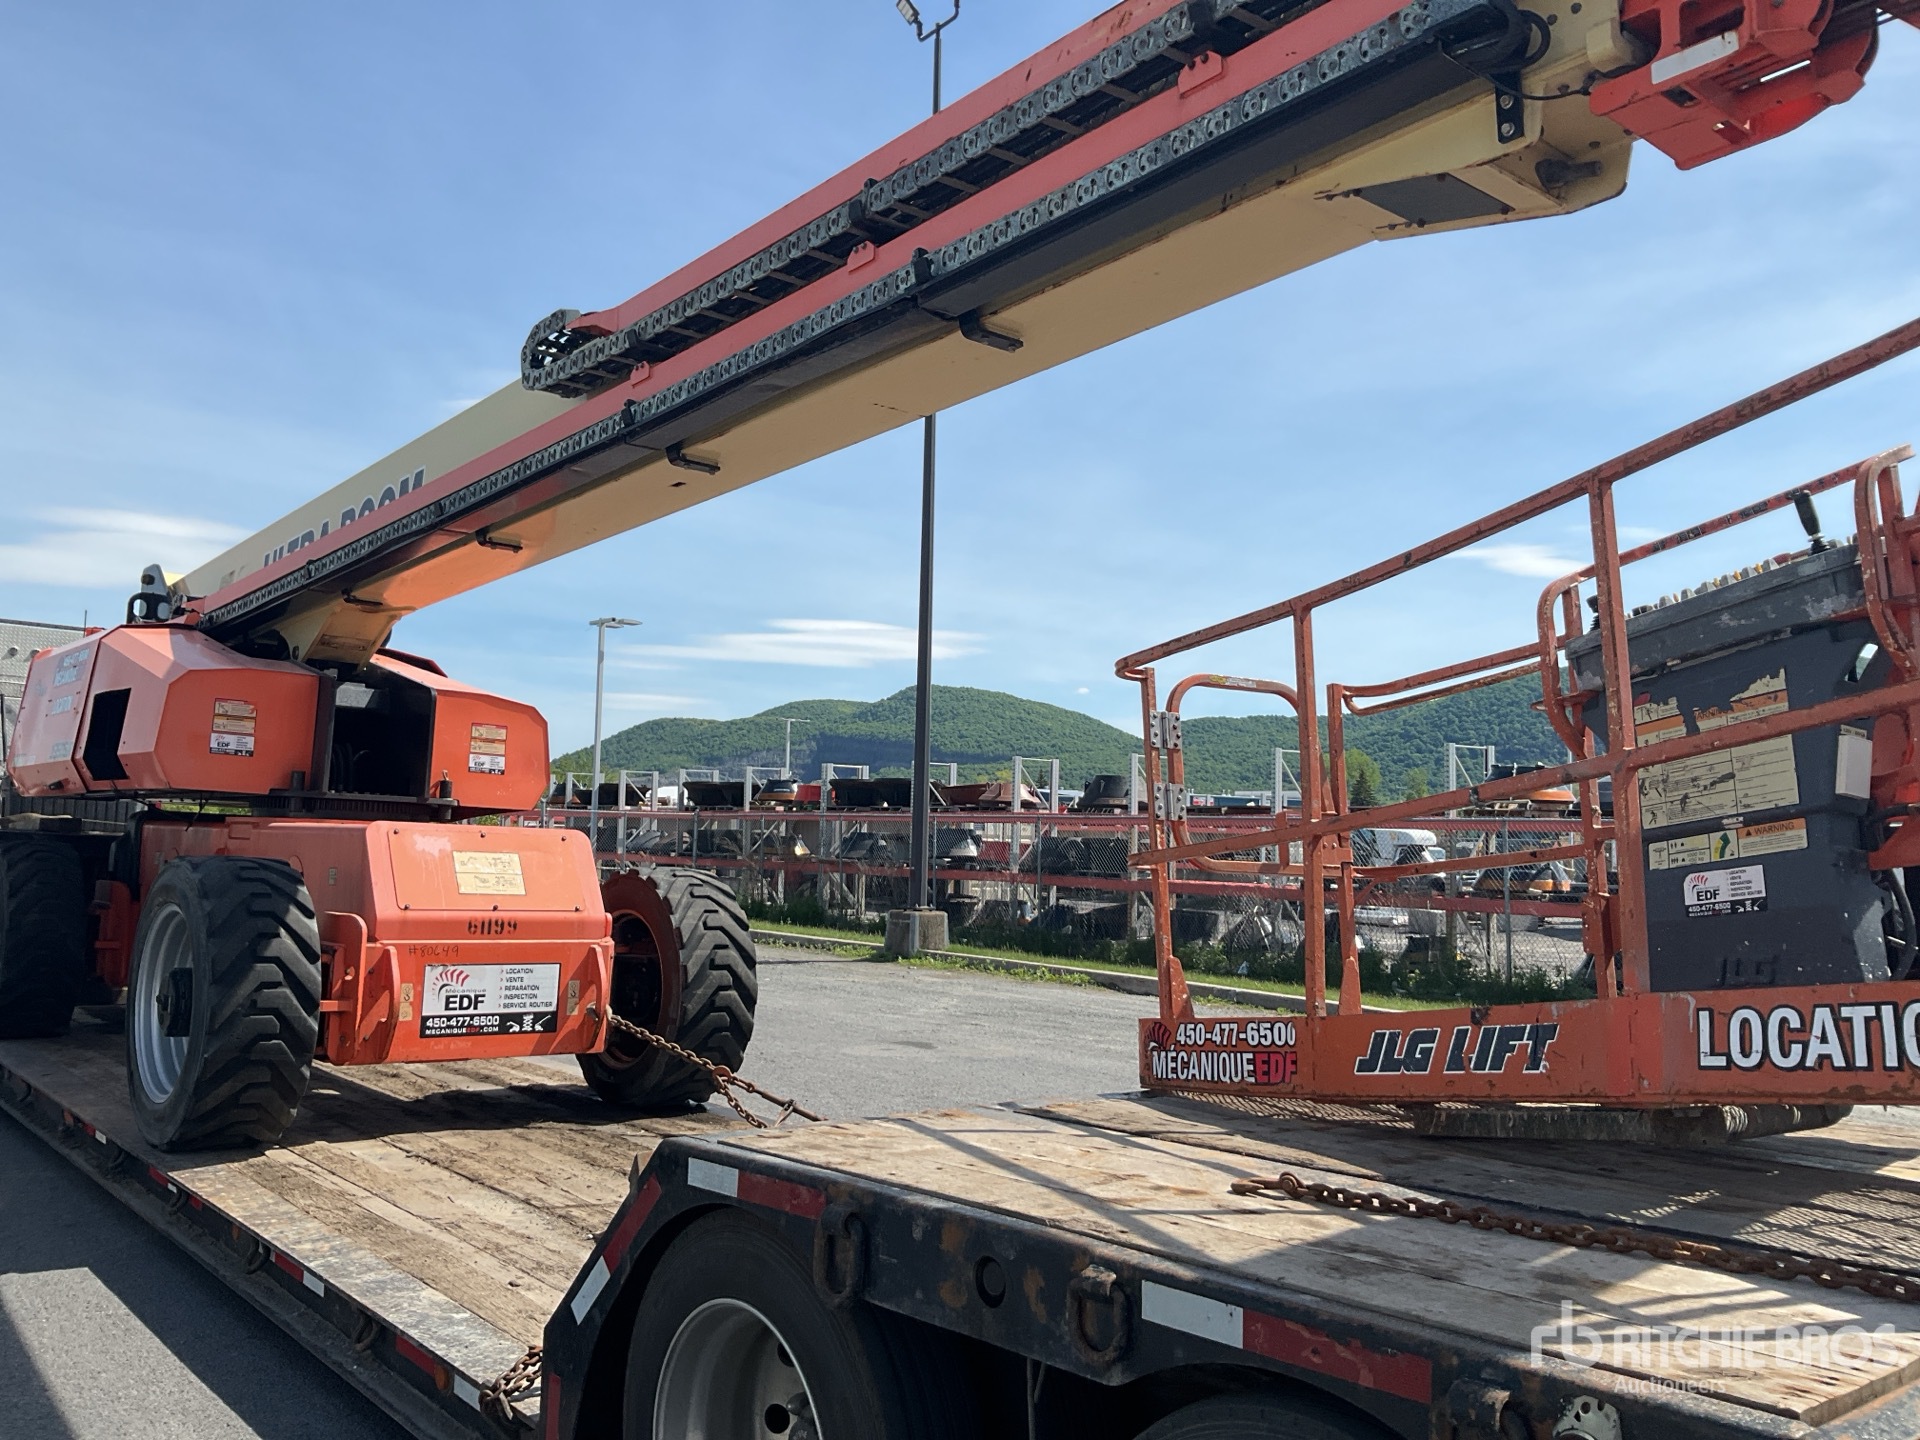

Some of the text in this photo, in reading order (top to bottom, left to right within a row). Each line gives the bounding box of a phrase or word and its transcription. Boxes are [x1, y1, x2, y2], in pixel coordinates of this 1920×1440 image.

[1754, 822, 1795, 835] WARNING
[1696, 889, 1720, 902] EDF
[467, 918, 518, 935] 61199
[444, 994, 487, 1011] EDF
[502, 1001, 527, 1009] SERVICE
[426, 1015, 500, 1028] 450-477-6500
[1176, 1021, 1297, 1047] 450-477-6500
[1354, 1023, 1559, 1075] JLG LIFT
